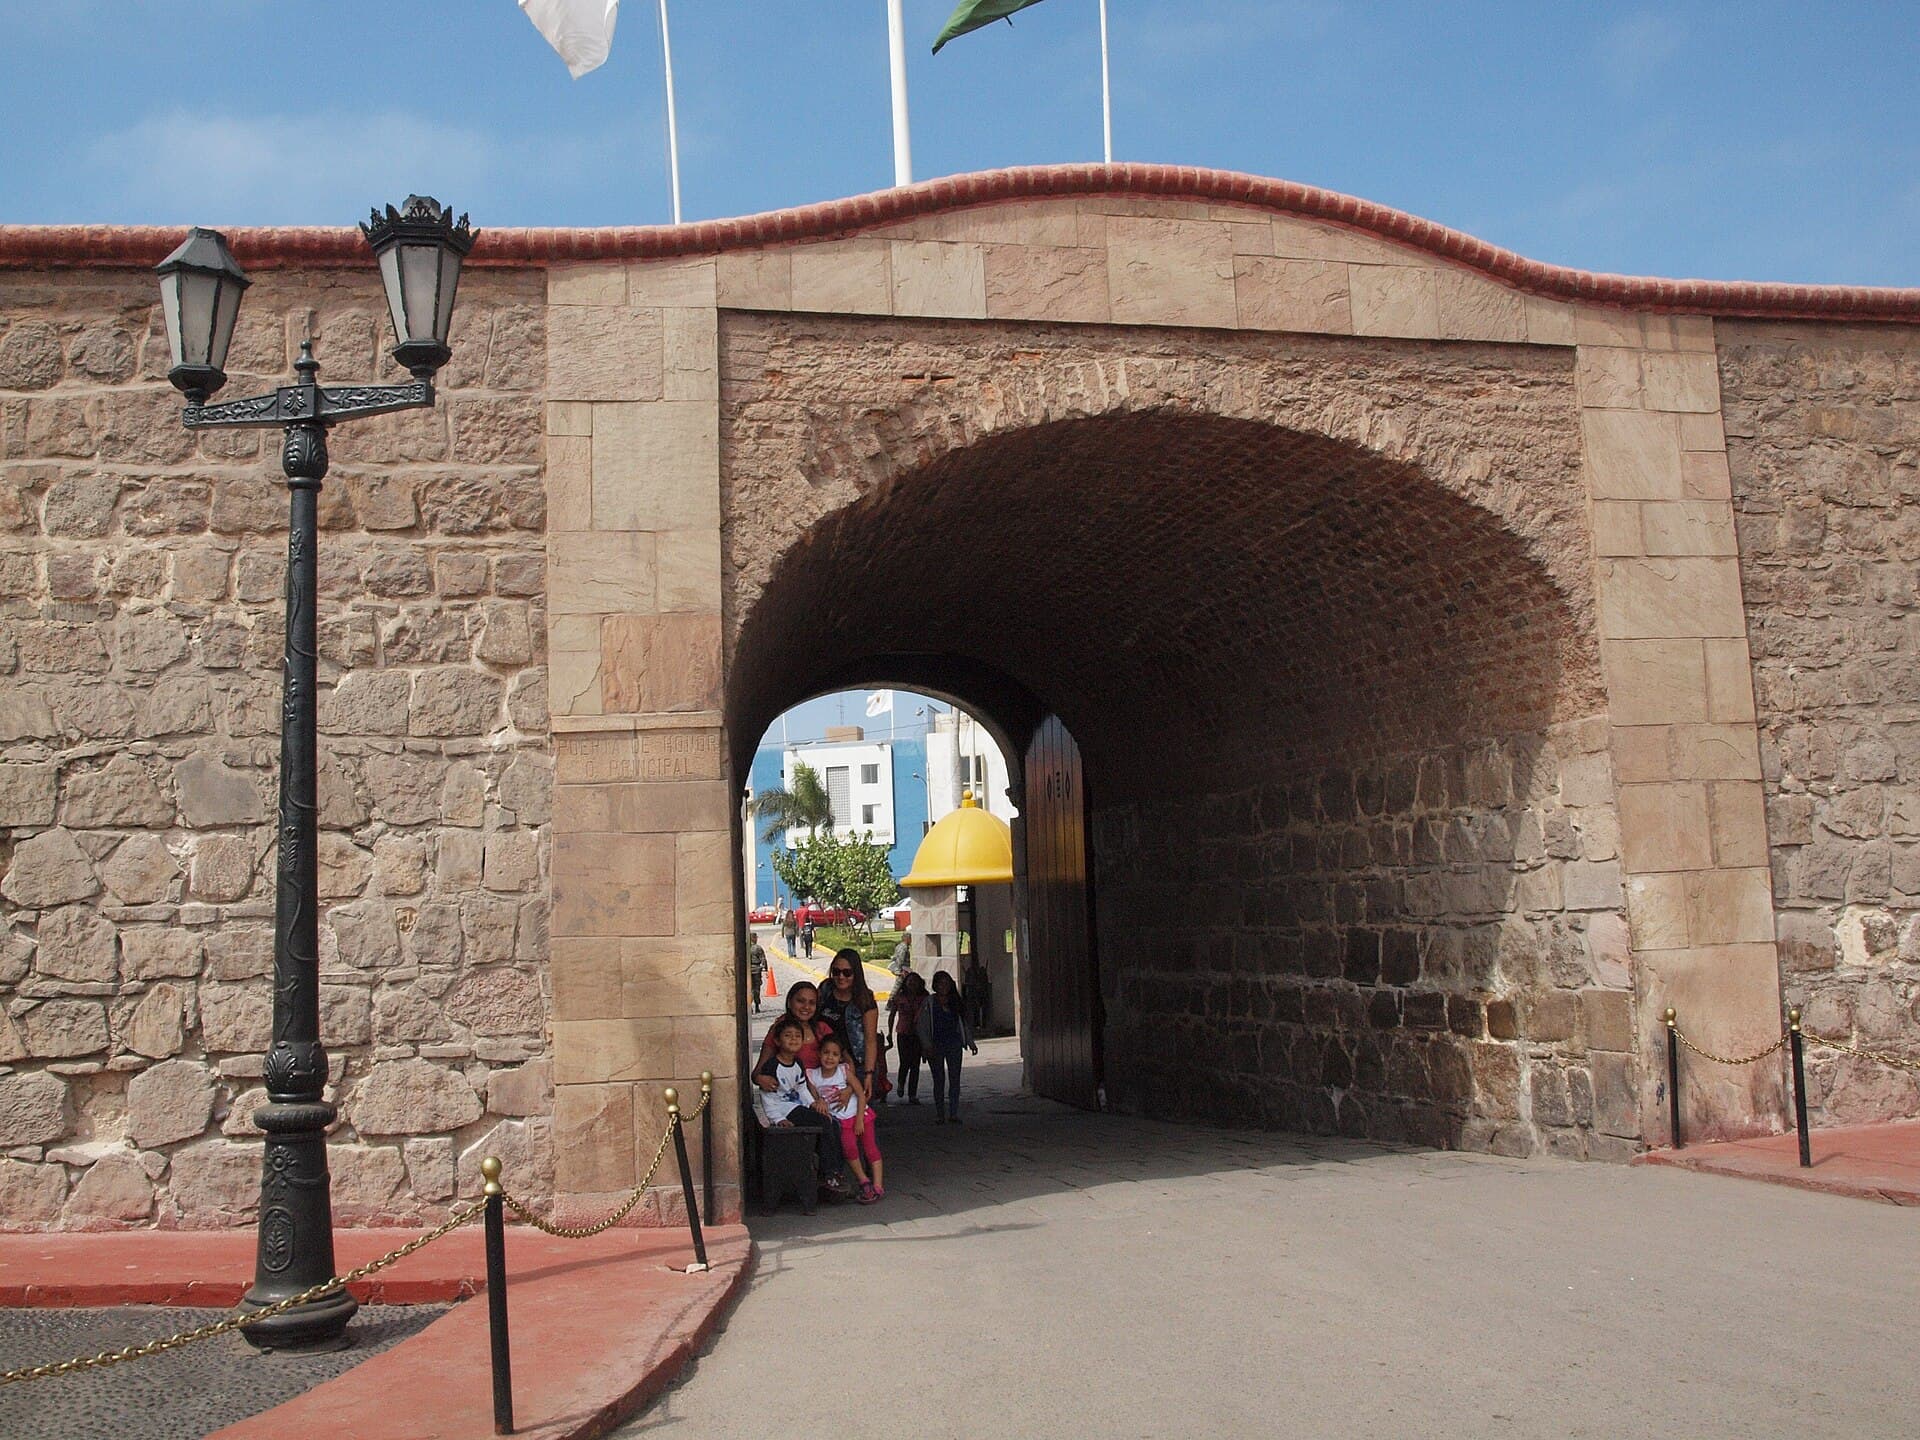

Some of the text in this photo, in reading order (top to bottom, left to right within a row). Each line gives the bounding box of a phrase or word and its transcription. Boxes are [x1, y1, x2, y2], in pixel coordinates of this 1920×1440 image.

[558, 734, 718, 755] PUERTA DE HONOR
[609, 757, 694, 777] PRINCIPAL
